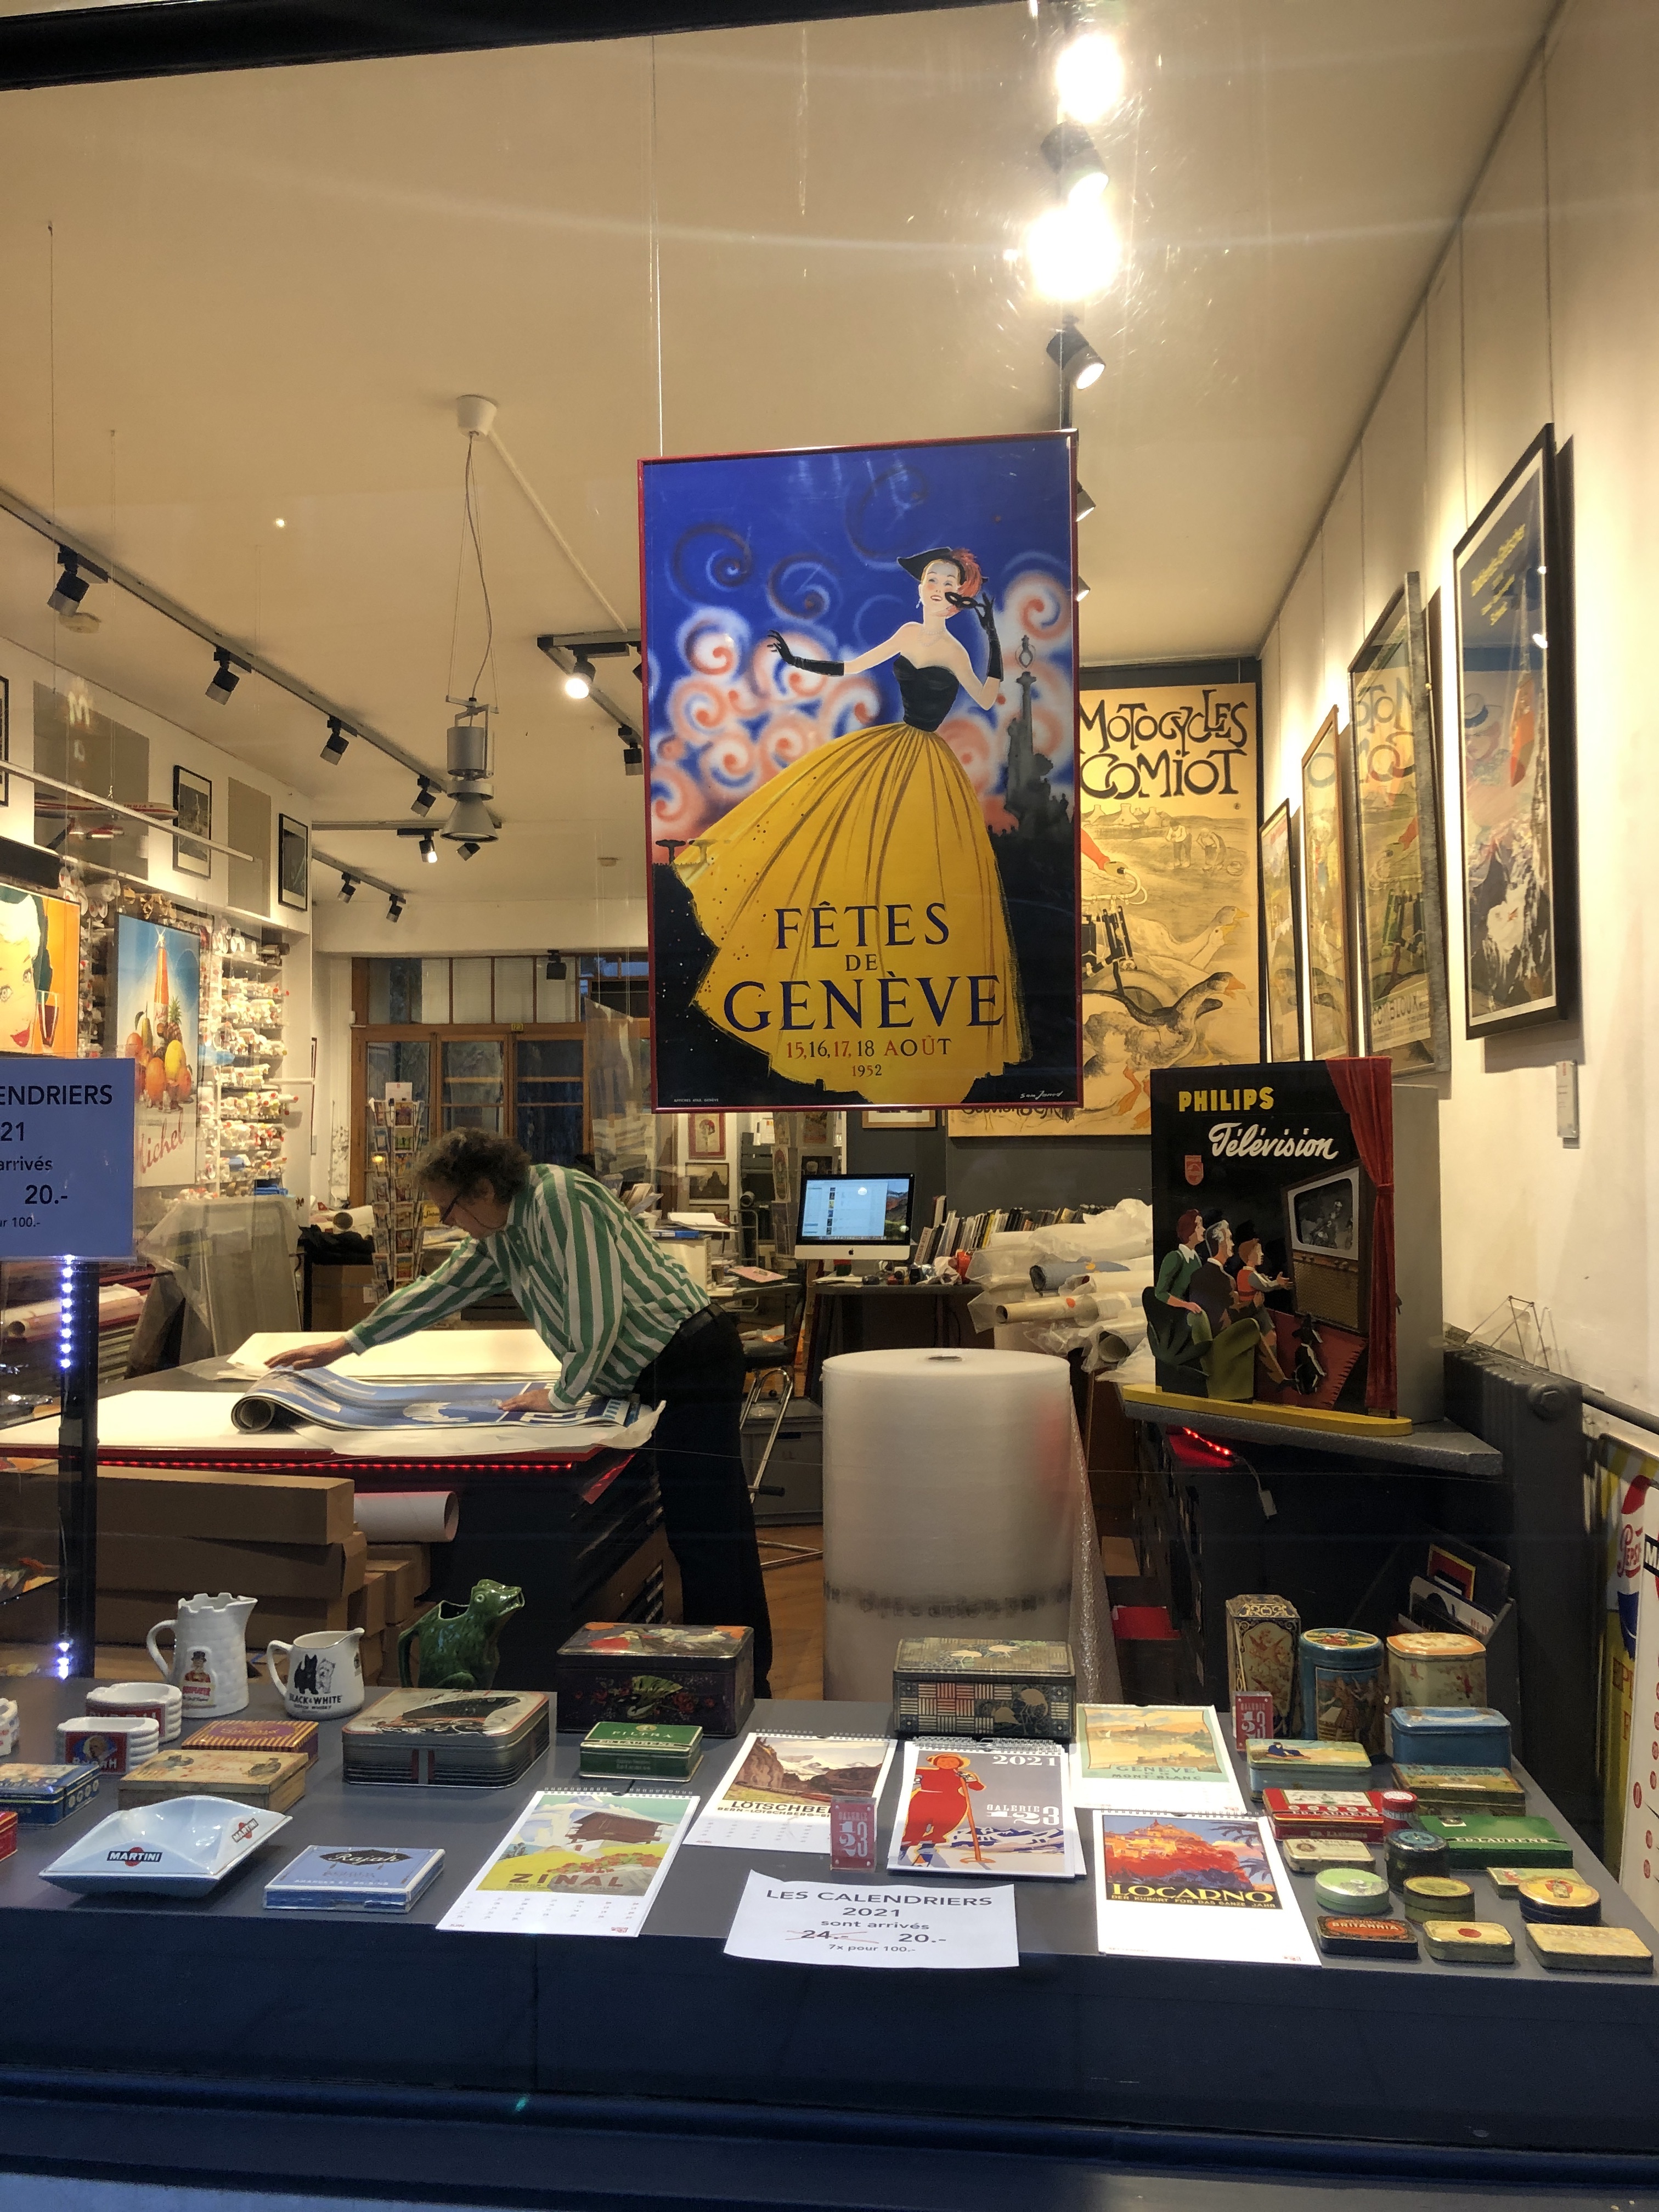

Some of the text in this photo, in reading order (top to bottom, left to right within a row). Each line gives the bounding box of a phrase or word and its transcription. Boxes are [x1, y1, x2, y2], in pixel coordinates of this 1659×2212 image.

[774, 901, 950, 950] FÊTES
[845, 954, 878, 972] DE
[723, 971, 1005, 1032] GENÈVE
[884, 1035, 952, 1056] AOÛT
[851, 1064, 883, 1078] 1952
[1178, 1086, 1275, 1113] PHILIPS
[138, 1107, 186, 1174] ichel
[1207, 1122, 1339, 1160] Télévision
[25, 1184, 68, 1205] 20.-
[313, 1695, 342, 1705] WHITE
[612, 1730, 673, 1739] FILTRA
[992, 1755, 1058, 1767] 2021
[731, 1801, 831, 1814] LÖTSCHBE
[986, 1804, 1040, 1813] GALERIE
[232, 1819, 258, 1842] MARTINI
[109, 1852, 161, 1861] MARTINI
[328, 1853, 399, 1865] Rajah
[509, 1873, 624, 1888] ZINAL
[766, 1889, 993, 1906] LES CALENDRIERS
[1111, 1883, 1274, 1903] LOCARNO
[842, 1907, 900, 1917] 2021
[821, 1920, 930, 1930] sont arrivés
[1331, 1921, 1400, 1931] BRITANNIA
[898, 1933, 947, 1944] 20.-
